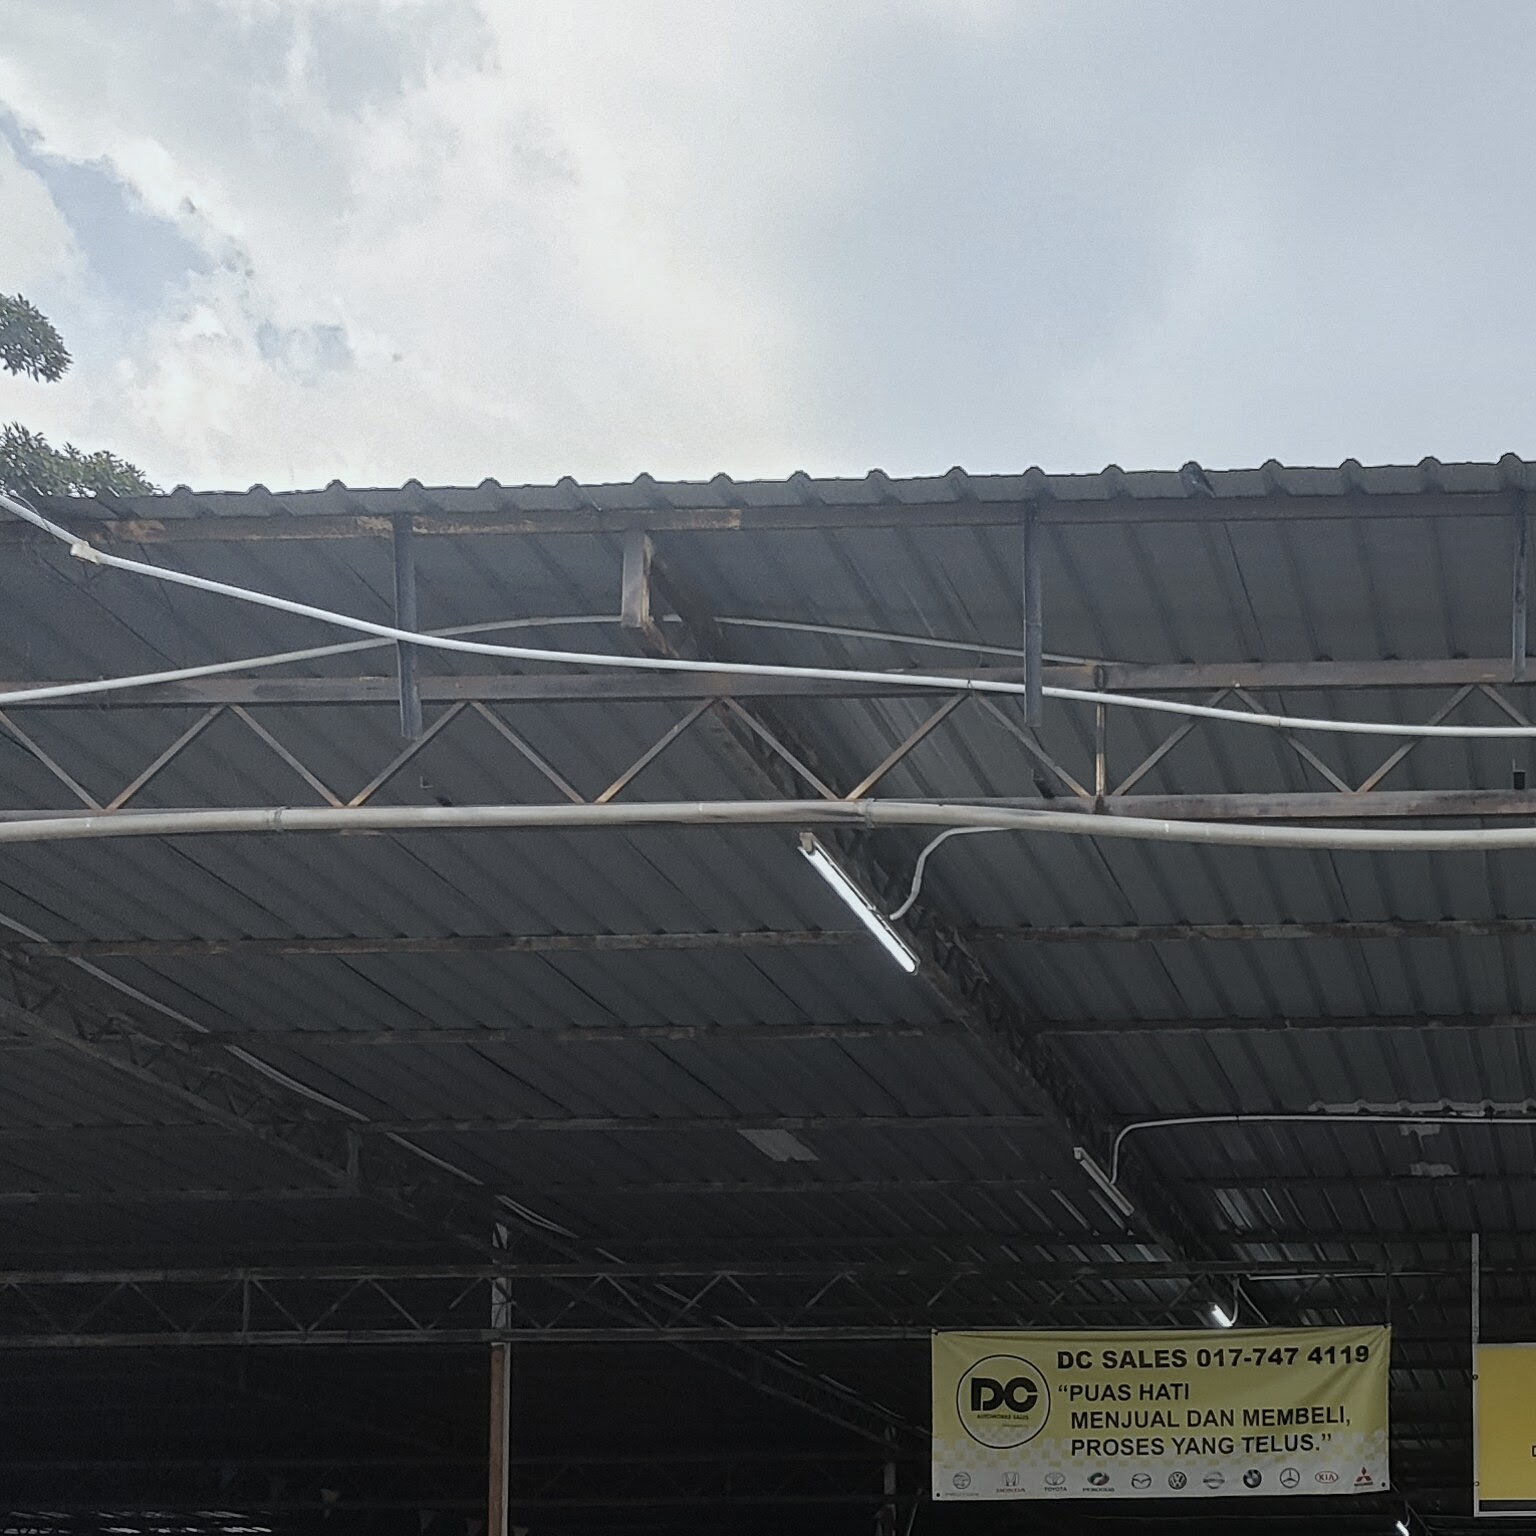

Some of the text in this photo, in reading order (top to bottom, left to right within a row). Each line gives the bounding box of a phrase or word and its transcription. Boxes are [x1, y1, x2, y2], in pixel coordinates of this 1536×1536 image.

[1057, 1345, 1370, 1369] DC SALES 017-747 4119
[971, 1377, 1038, 1413] DC
[1139, 1383, 1189, 1401] HATI
[1071, 1405, 1350, 1429] MENJUAL DAN MEMBELI,
[1071, 1437, 1165, 1456] PROSES
[1171, 1437, 1234, 1455] YANG
